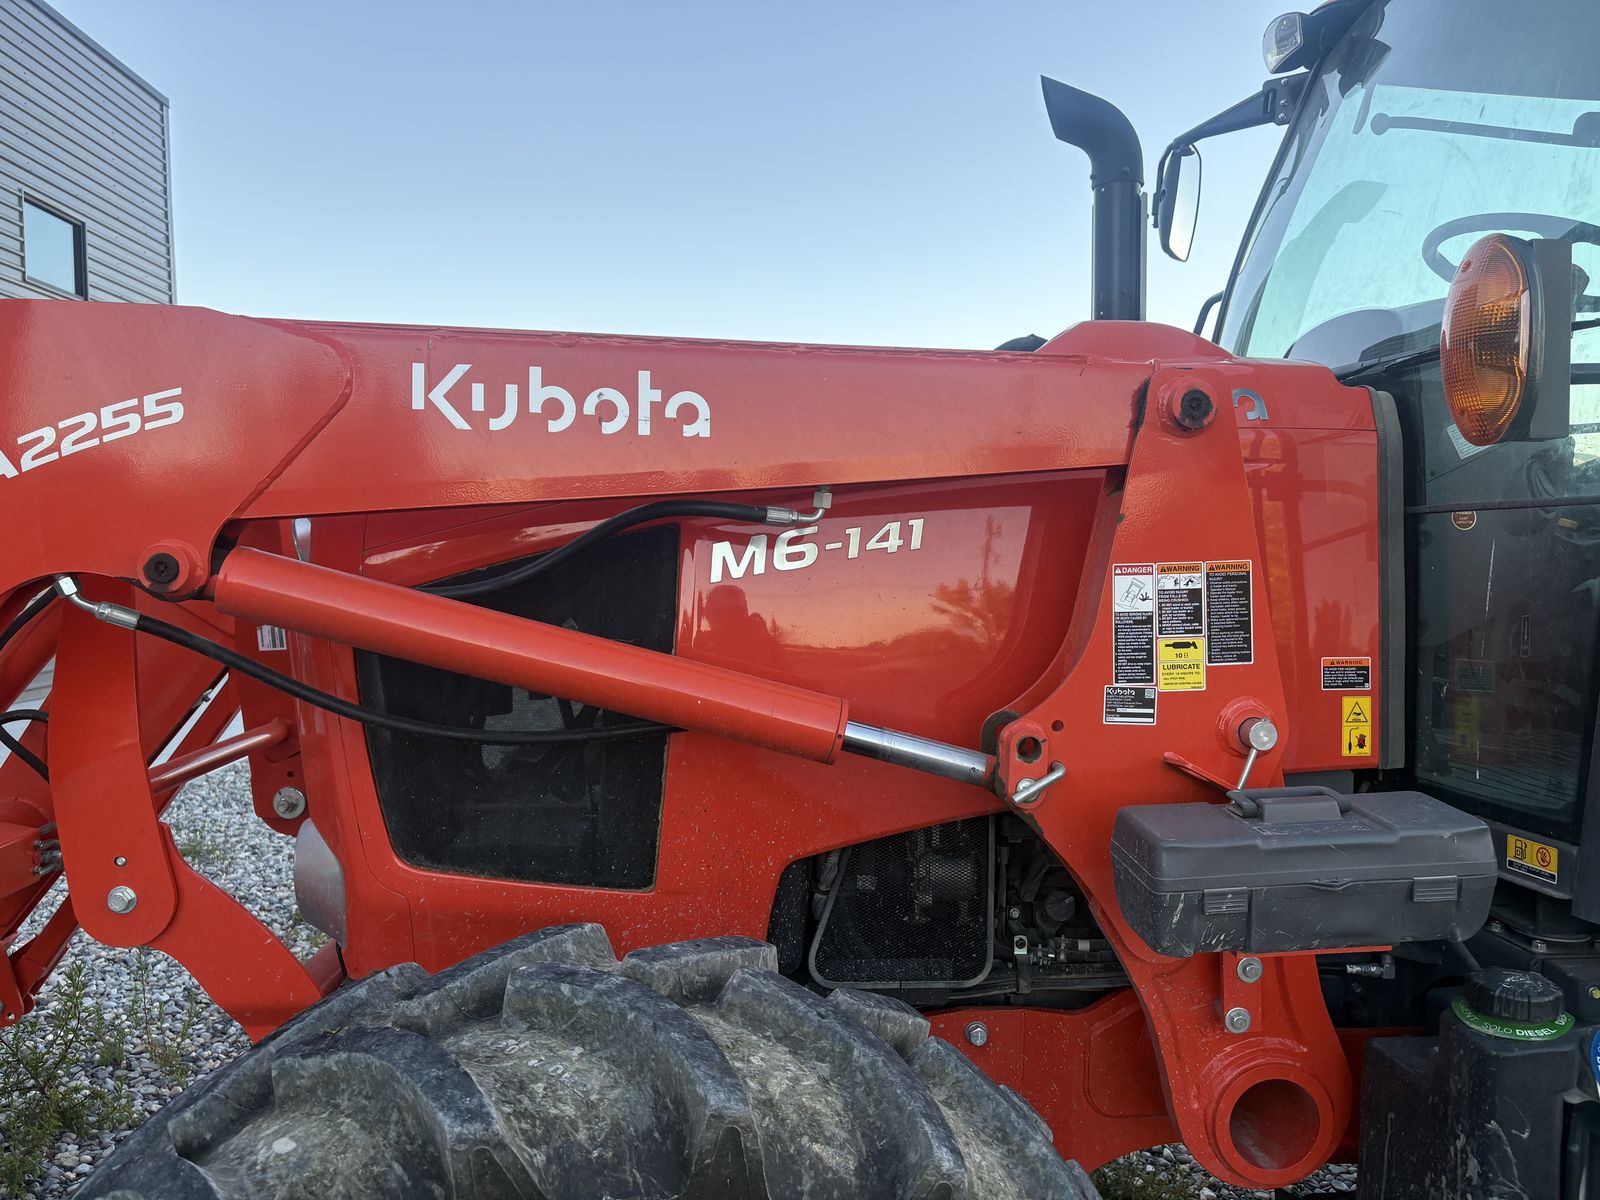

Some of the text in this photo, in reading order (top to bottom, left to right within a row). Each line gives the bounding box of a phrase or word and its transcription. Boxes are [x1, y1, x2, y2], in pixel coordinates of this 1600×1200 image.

[412, 362, 711, 437] Kubota
[710, 518, 925, 583] M6-141
[1166, 565, 1200, 573] WARNING
[1215, 563, 1248, 572] WARNING
[1482, 1022, 1513, 1035] SOLO
[1516, 1028, 1557, 1037] DIESEL
